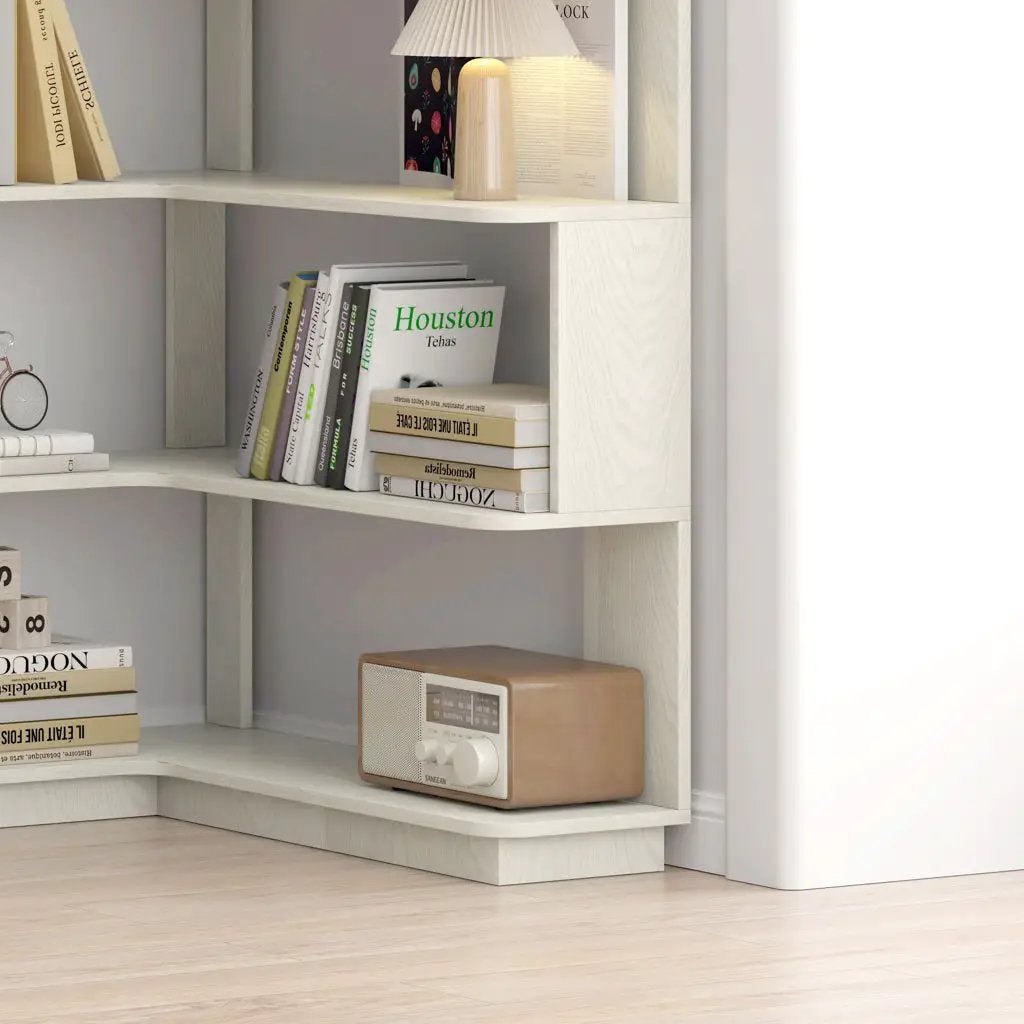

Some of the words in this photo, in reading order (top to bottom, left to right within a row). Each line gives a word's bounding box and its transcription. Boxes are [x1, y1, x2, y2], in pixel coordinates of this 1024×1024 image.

[332, 301, 350, 370] Brisbane
[361, 307, 378, 372] Houston
[393, 305, 495, 332] Houston
[425, 334, 457, 349] Tehas
[241, 370, 264, 451] WASHINGTON
[330, 417, 342, 470] FORMULA
[340, 372, 348, 397] FOR
[346, 304, 358, 355] SUCCESS
